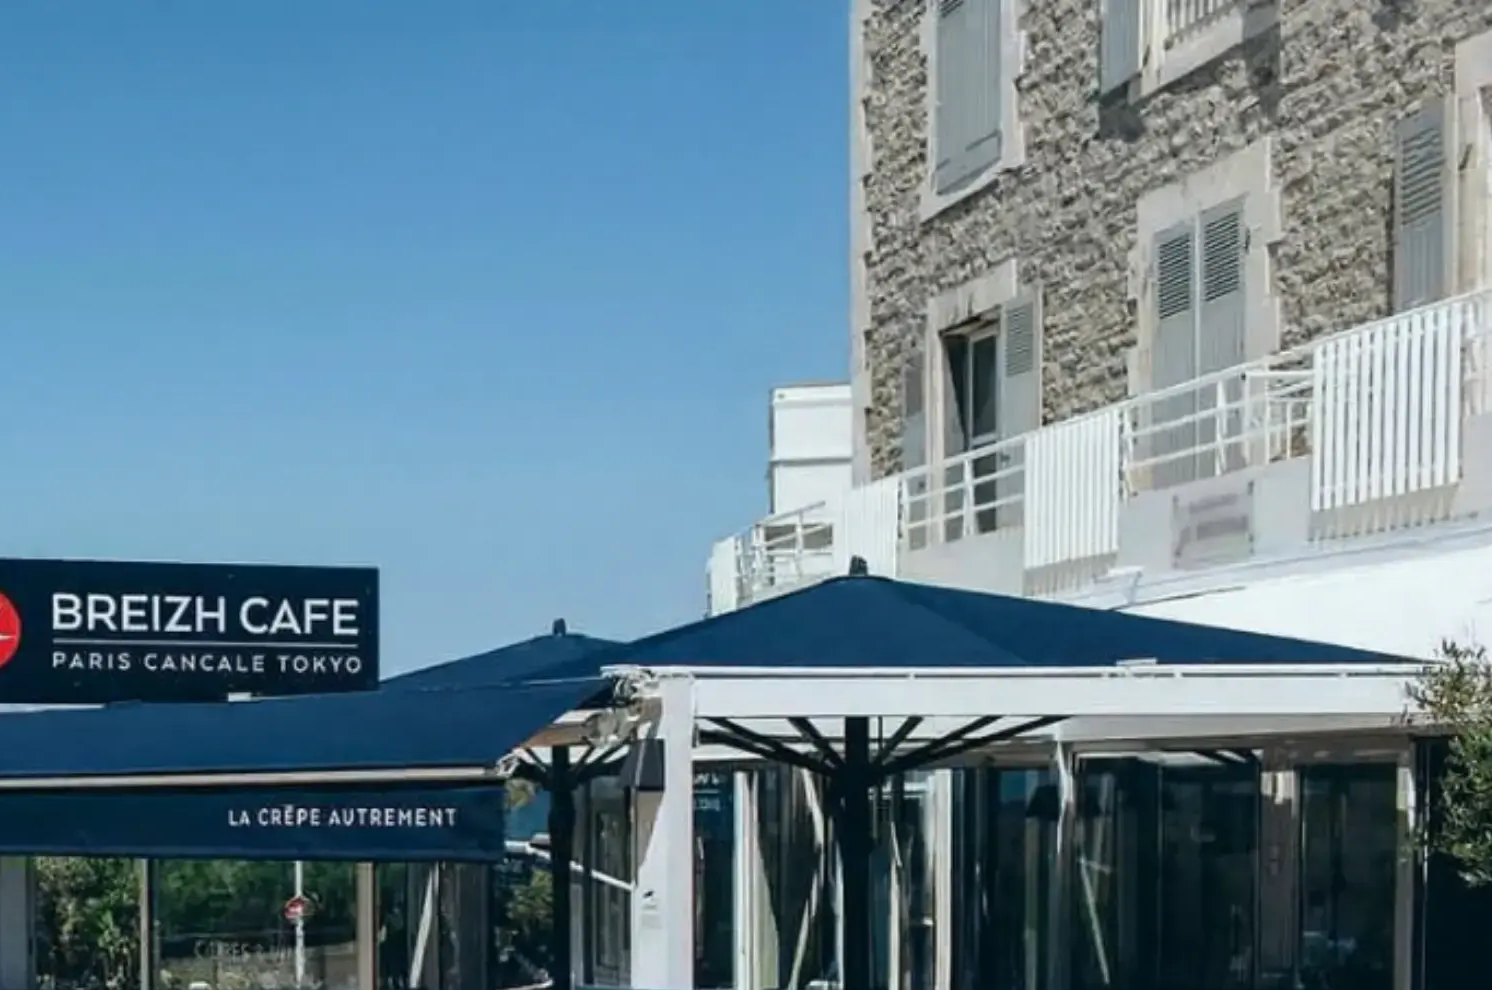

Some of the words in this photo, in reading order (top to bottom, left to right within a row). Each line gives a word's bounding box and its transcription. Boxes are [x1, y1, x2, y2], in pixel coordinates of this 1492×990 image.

[52, 592, 226, 632] BREIZH
[239, 597, 359, 636] CAFE
[52, 651, 131, 671] PARIS
[143, 653, 265, 673] CANCALE
[277, 654, 362, 674] TOKYO
[228, 810, 251, 827] LA
[257, 803, 321, 827] CRÊPE
[328, 807, 456, 827] AUTREMENT
